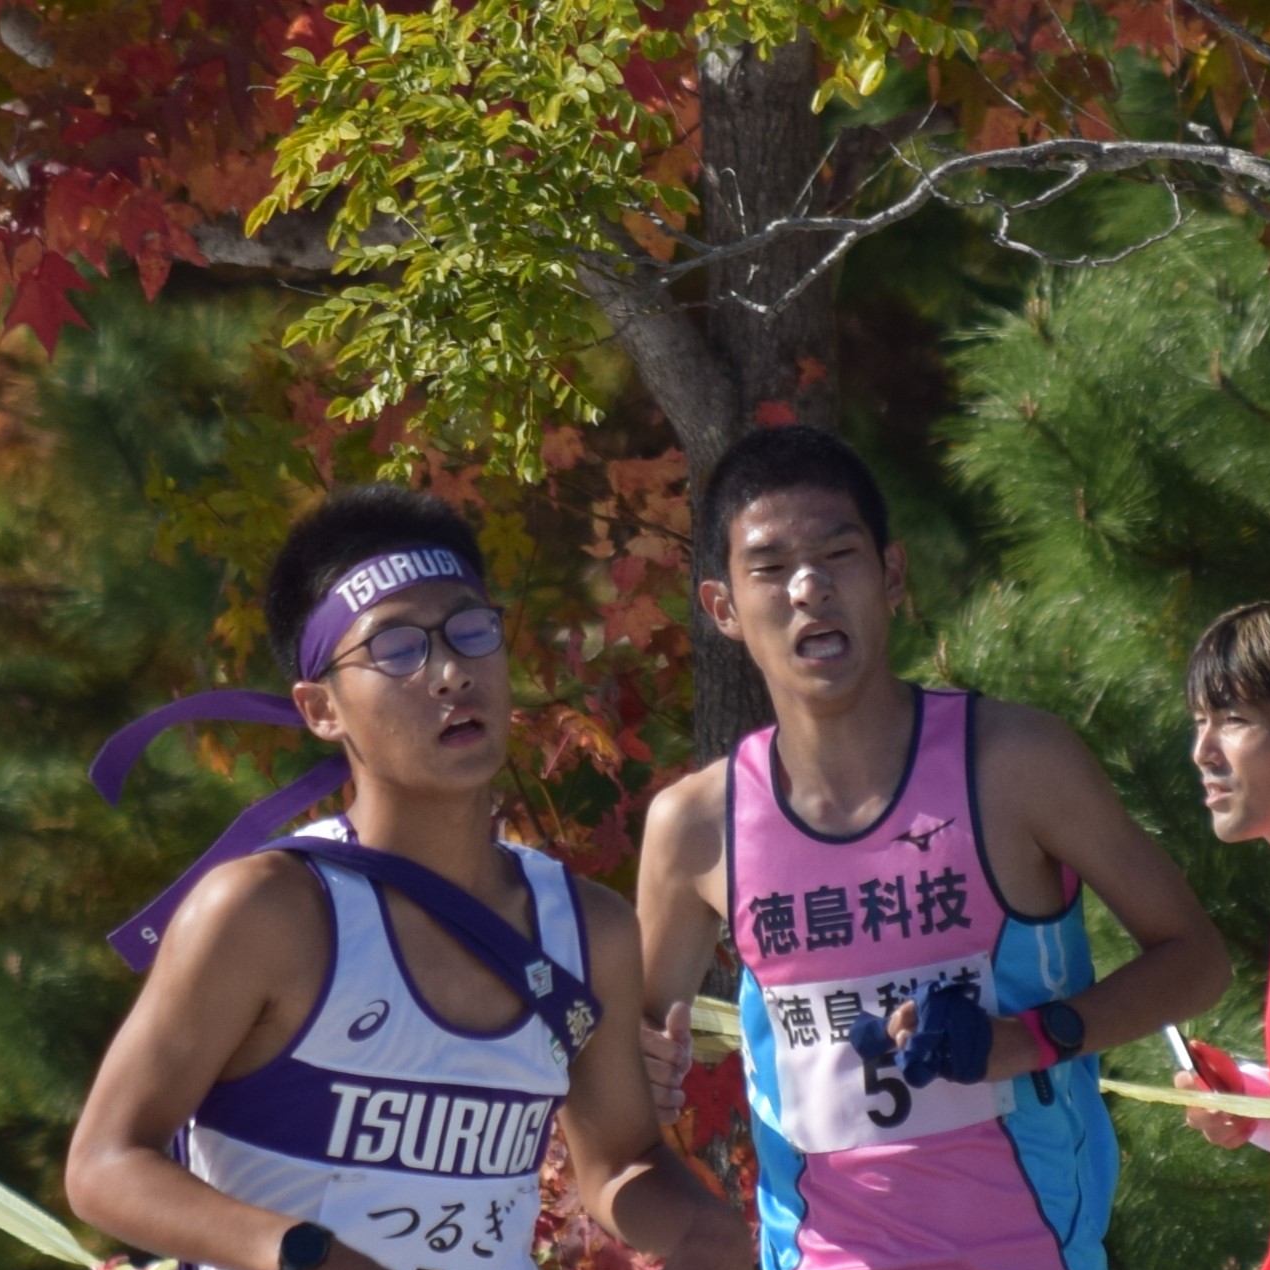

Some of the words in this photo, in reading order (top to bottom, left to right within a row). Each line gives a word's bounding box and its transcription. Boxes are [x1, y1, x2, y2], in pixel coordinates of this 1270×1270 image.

[335, 548, 463, 613] TSURUGI
[749, 866, 972, 959] 徳島科技
[863, 1051, 912, 1128] 5
[326, 1082, 554, 1176] TSURUGI
[367, 1200, 516, 1259] つるぎ
